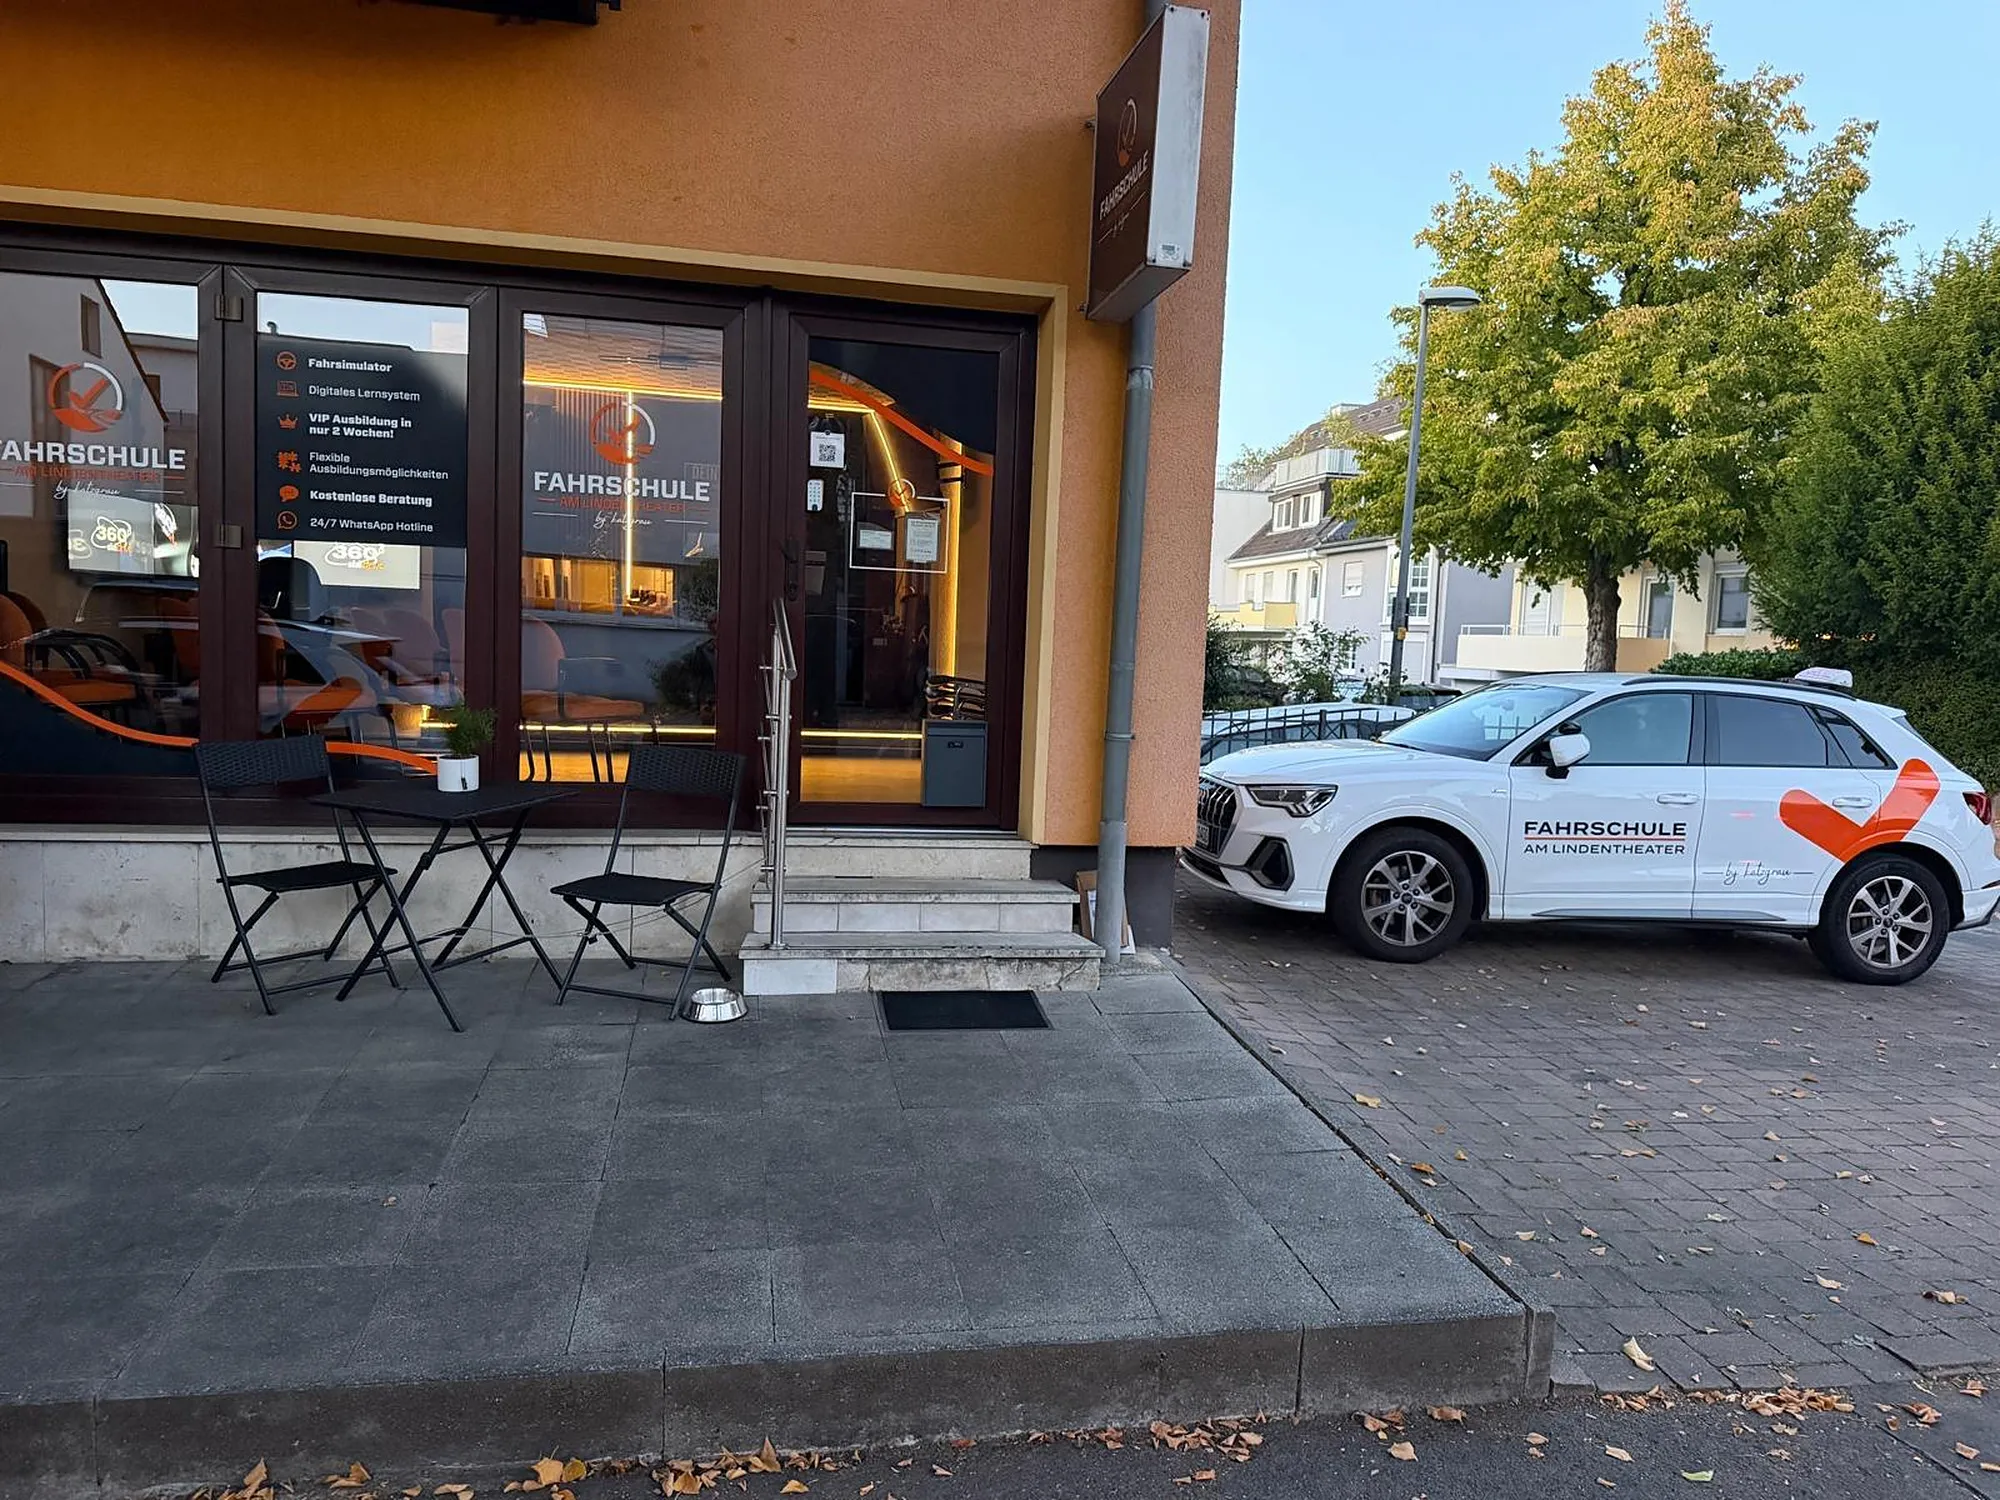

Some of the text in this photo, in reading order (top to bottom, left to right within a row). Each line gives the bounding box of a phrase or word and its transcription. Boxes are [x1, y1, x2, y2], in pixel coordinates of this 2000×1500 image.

[308, 358, 393, 372] Fahrsimulator
[308, 385, 421, 401] Digitales Lernsystem
[308, 413, 412, 429] VIP Ausbildung in
[309, 426, 394, 439] nur 2 Wochen!
[0, 439, 186, 470] AHRSCHULE
[309, 452, 351, 463] Flexible
[309, 463, 449, 480] Ausbildungsmöglichkeiten
[53, 480, 68, 499] by
[534, 471, 710, 502] FAHRSCHULE
[309, 490, 433, 508] Kostenlose Beratung
[310, 518, 433, 533] 24/7 WhatsApp Hotline
[593, 511, 606, 529] by
[1524, 821, 1687, 836] FAHRSCHULE
[1523, 844, 1685, 855] AM LINDENTHEATER
[1724, 861, 1738, 885] by
